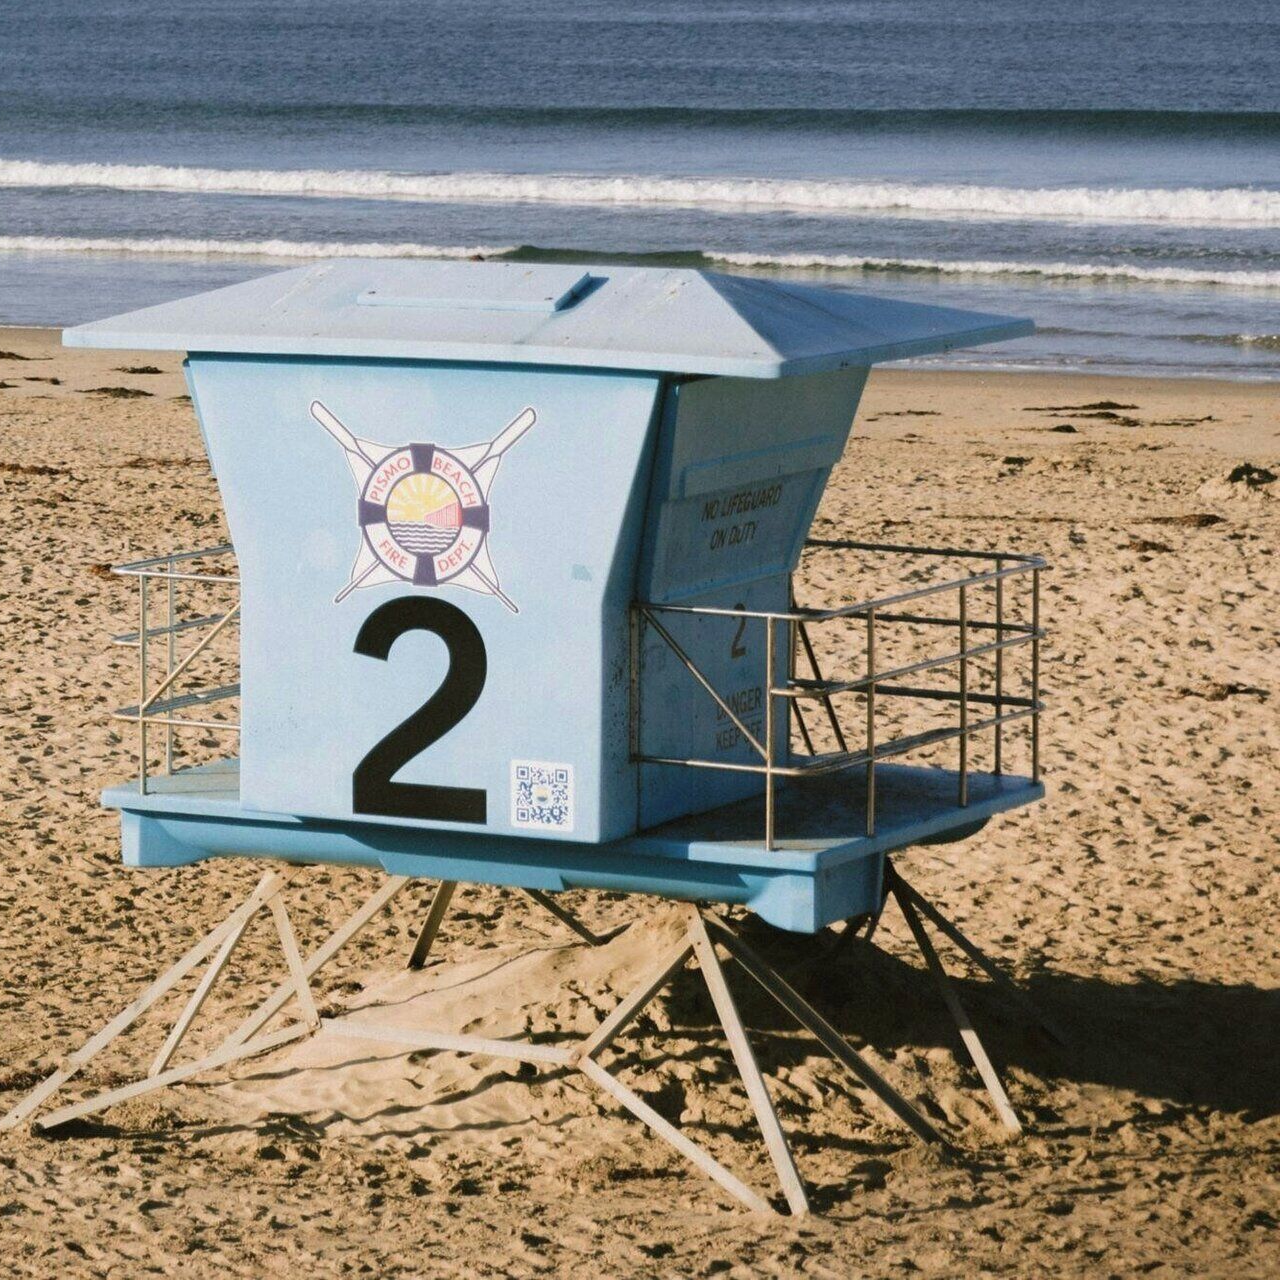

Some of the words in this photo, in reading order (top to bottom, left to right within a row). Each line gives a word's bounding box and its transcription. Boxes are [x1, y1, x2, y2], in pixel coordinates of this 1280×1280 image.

[369, 456, 411, 502] PISMO
[433, 456, 477, 506] BEACH
[701, 499, 719, 522] NO
[721, 484, 782, 517] LIFEGUARD
[710, 527, 727, 551] ON
[728, 520, 759, 546] DUTY
[378, 539, 409, 569] FIRE
[437, 539, 474, 573] DEPT.
[731, 602, 747, 659] 2
[353, 595, 488, 825] 2
[717, 687, 762, 720] DANGER
[715, 726, 741, 753] KEEP
